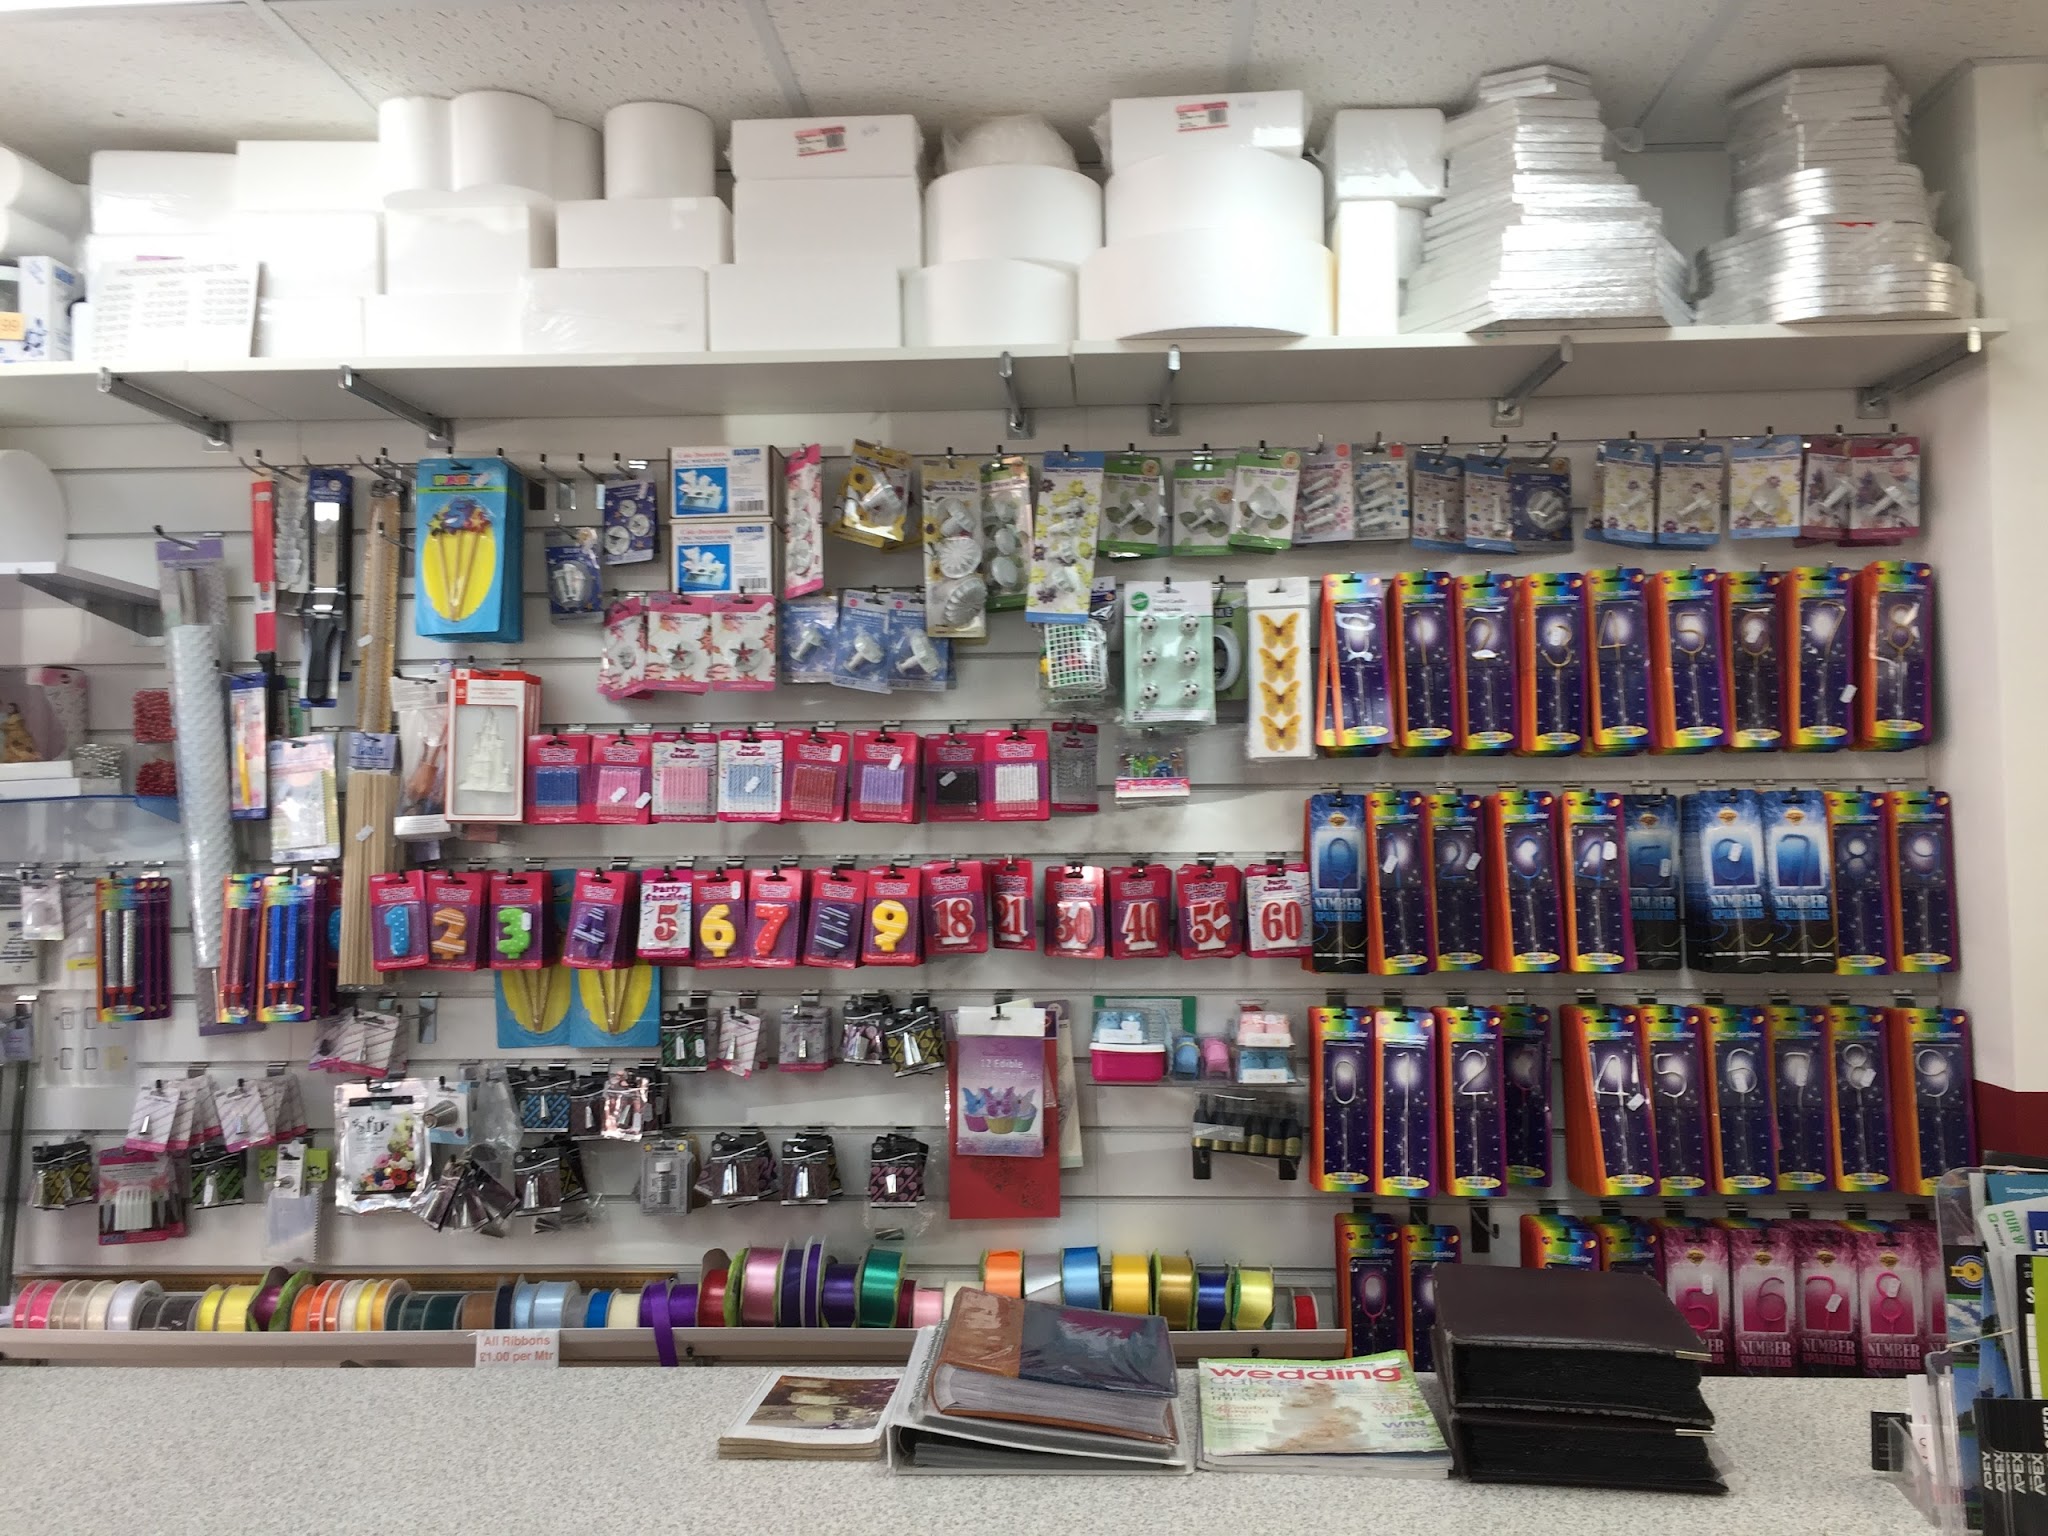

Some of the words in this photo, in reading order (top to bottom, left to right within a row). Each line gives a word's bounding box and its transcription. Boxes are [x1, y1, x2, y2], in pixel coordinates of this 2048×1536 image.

[996, 745, 1035, 753] Birthday
[998, 751, 1033, 759] Candles
[931, 877, 970, 885] Birthday
[1120, 881, 1155, 890] Birthday
[652, 886, 681, 894] Party
[758, 884, 793, 893] Birthday
[822, 883, 857, 893] Birthday
[875, 883, 911, 891] Birthday
[1056, 883, 1096, 892] Birthday
[1122, 888, 1154, 897] Candles
[1184, 882, 1228, 892] Birthday
[645, 892, 688, 902] Candles
[1058, 890, 1093, 898] Candles
[1188, 890, 1226, 899] Candles
[1314, 897, 1363, 911] NUMBER
[1711, 894, 1763, 909] NUMBER
[1774, 895, 1829, 909] NUMBER
[933, 897, 975, 938] 18
[996, 895, 1027, 936] 21
[1262, 901, 1302, 941] 60
[654, 904, 680, 940] 5
[1123, 902, 1159, 943] 40
[994, 1058, 1023, 1069] Edible
[2002, 1210, 2021, 1233] OUR
[484, 1336, 498, 1346] All
[502, 1336, 550, 1347] Ribbons
[1803, 1338, 1856, 1354] NUMBER
[1740, 1340, 1791, 1356] NUMBER
[1867, 1342, 1920, 1358] NUMBER
[480, 1352, 510, 1363] £1.00
[513, 1353, 532, 1364] per
[535, 1351, 553, 1362] Mtr
[1210, 1366, 1402, 1383] wedding
[1210, 1377, 1303, 1387] cakes
[1381, 1419, 1426, 1429] WIN
[2012, 1453, 2027, 1495] APEX
[2032, 1453, 2047, 1496] APEX
